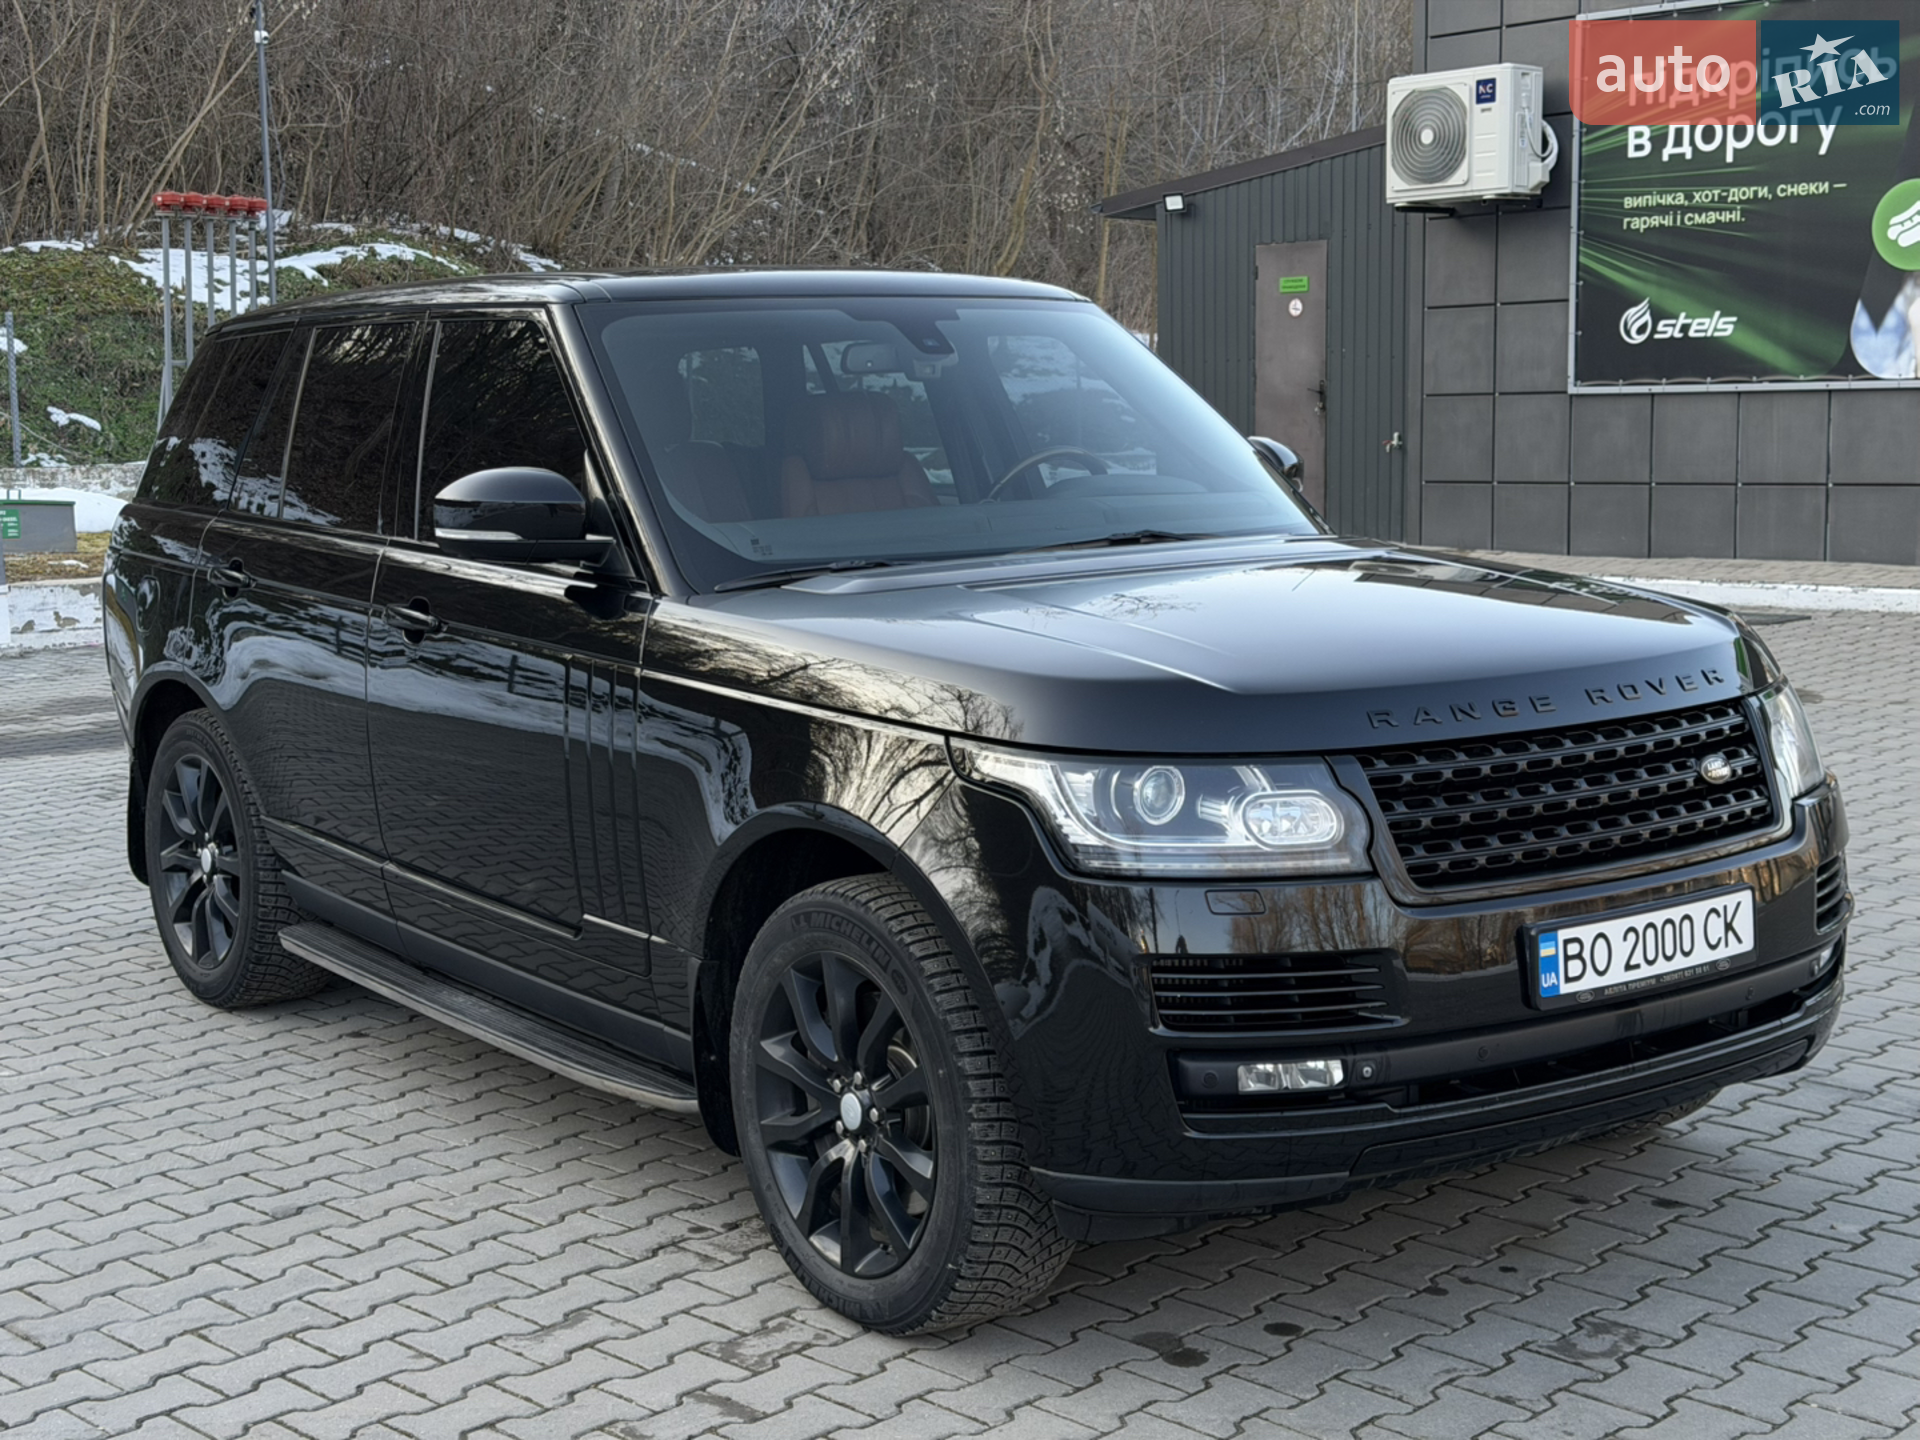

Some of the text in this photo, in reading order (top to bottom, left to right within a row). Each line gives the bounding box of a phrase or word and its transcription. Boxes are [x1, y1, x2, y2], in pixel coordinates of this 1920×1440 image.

[1627, 105, 1843, 163] в дорогу
[1623, 192, 1689, 209] випічка,
[1692, 184, 1772, 203] хот-доги,
[1776, 181, 1829, 198] снеки
[1623, 211, 1674, 233] гарячі
[1684, 206, 1746, 226] смачні.
[1653, 310, 1738, 339] stels
[1366, 668, 1725, 729] RANGE ROVER
[810, 911, 892, 969] MICHELIN
[1562, 900, 1744, 984] BO 2000 CK
[1541, 972, 1558, 988] UA
